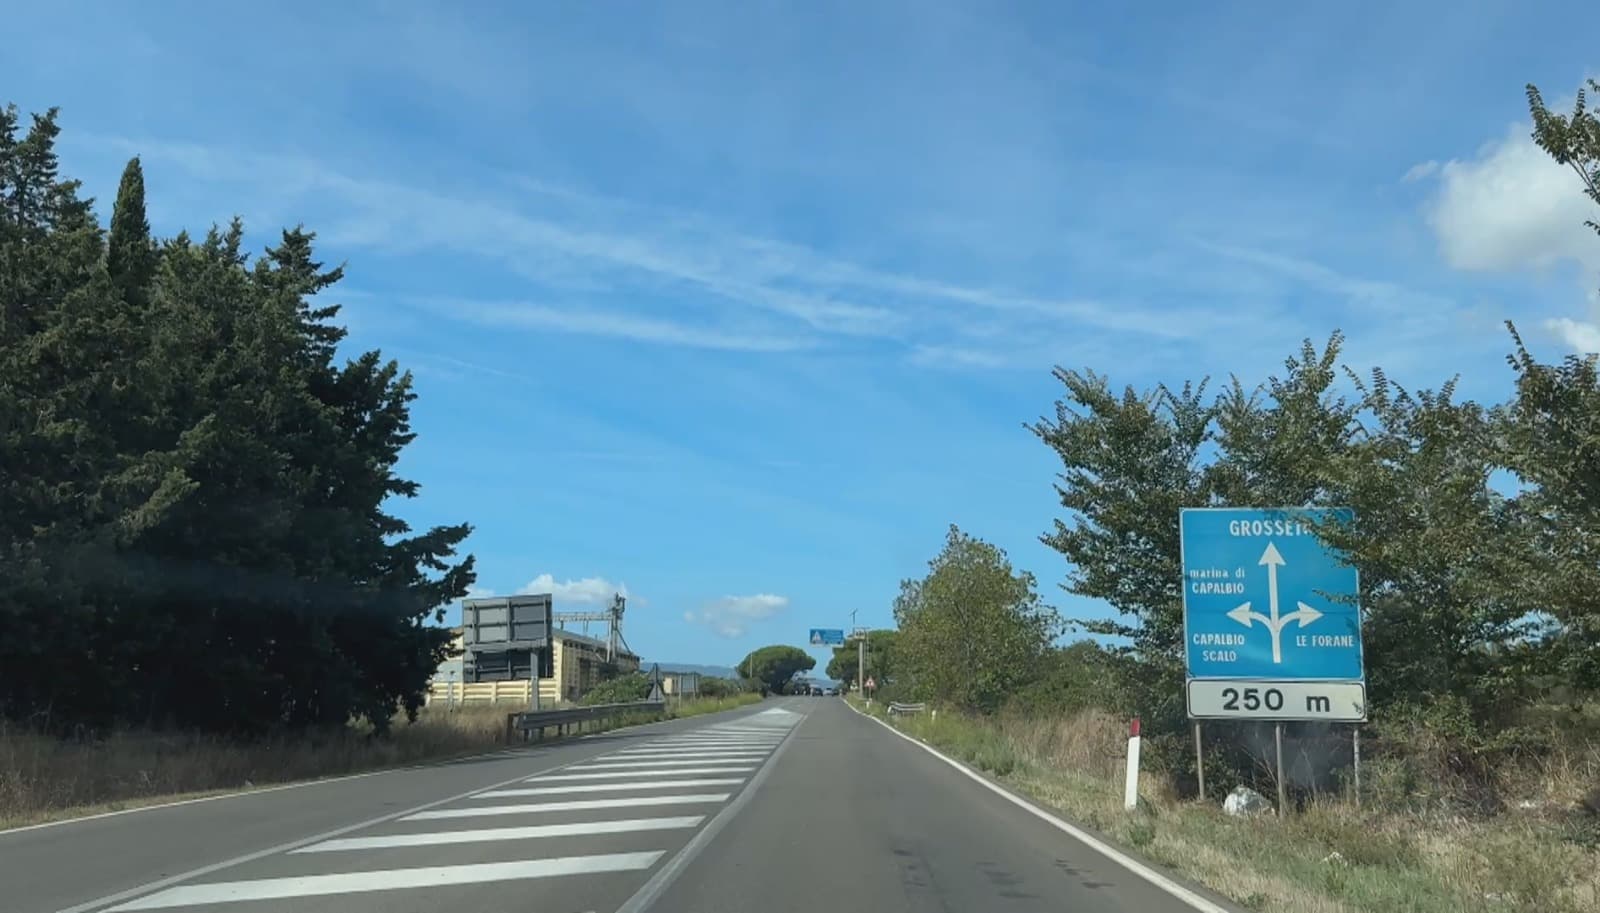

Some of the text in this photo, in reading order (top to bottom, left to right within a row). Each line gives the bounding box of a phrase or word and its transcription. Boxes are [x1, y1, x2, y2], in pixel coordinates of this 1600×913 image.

[1190, 567, 1245, 578] marina di
[1192, 582, 1245, 594] CAPALBIO
[1193, 633, 1245, 645] CAPALBIO
[1296, 635, 1354, 647] LE FORANE
[1202, 650, 1237, 662] SCALO
[1222, 688, 1330, 712] 250 m
